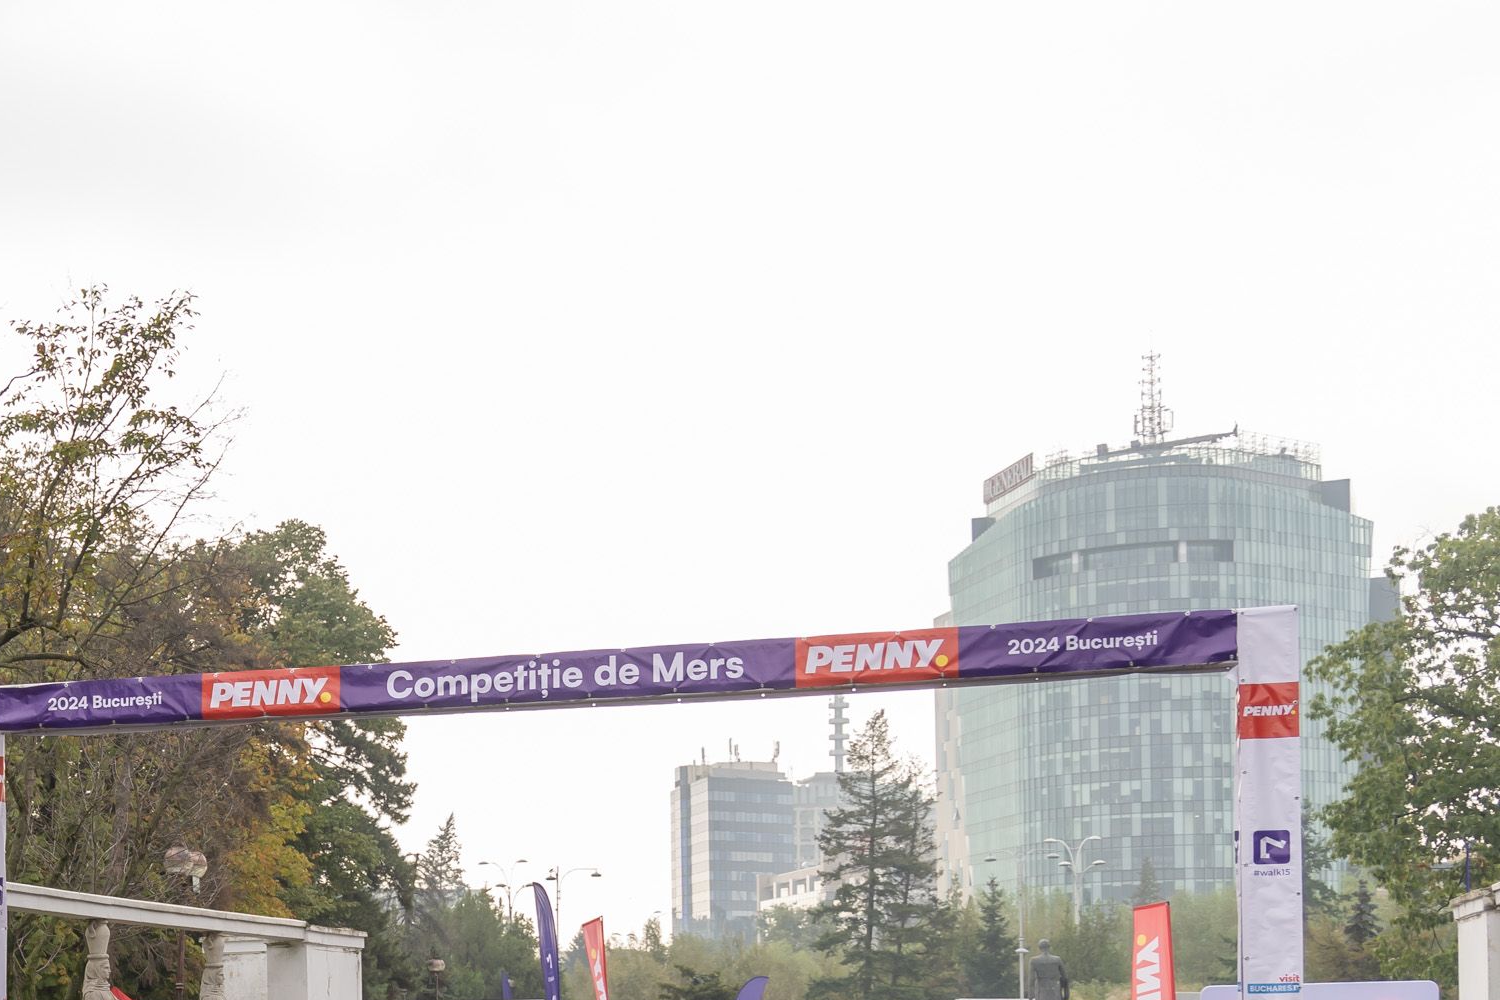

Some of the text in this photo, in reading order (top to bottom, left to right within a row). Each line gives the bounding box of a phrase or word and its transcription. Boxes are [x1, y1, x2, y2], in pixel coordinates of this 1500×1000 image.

[1007, 630, 1158, 655] 2024 București
[386, 651, 744, 702] Competiție de Mers
[47, 691, 162, 711] 2024 București
[1254, 868, 1291, 876] #walk15
[1279, 974, 1300, 983] visit
